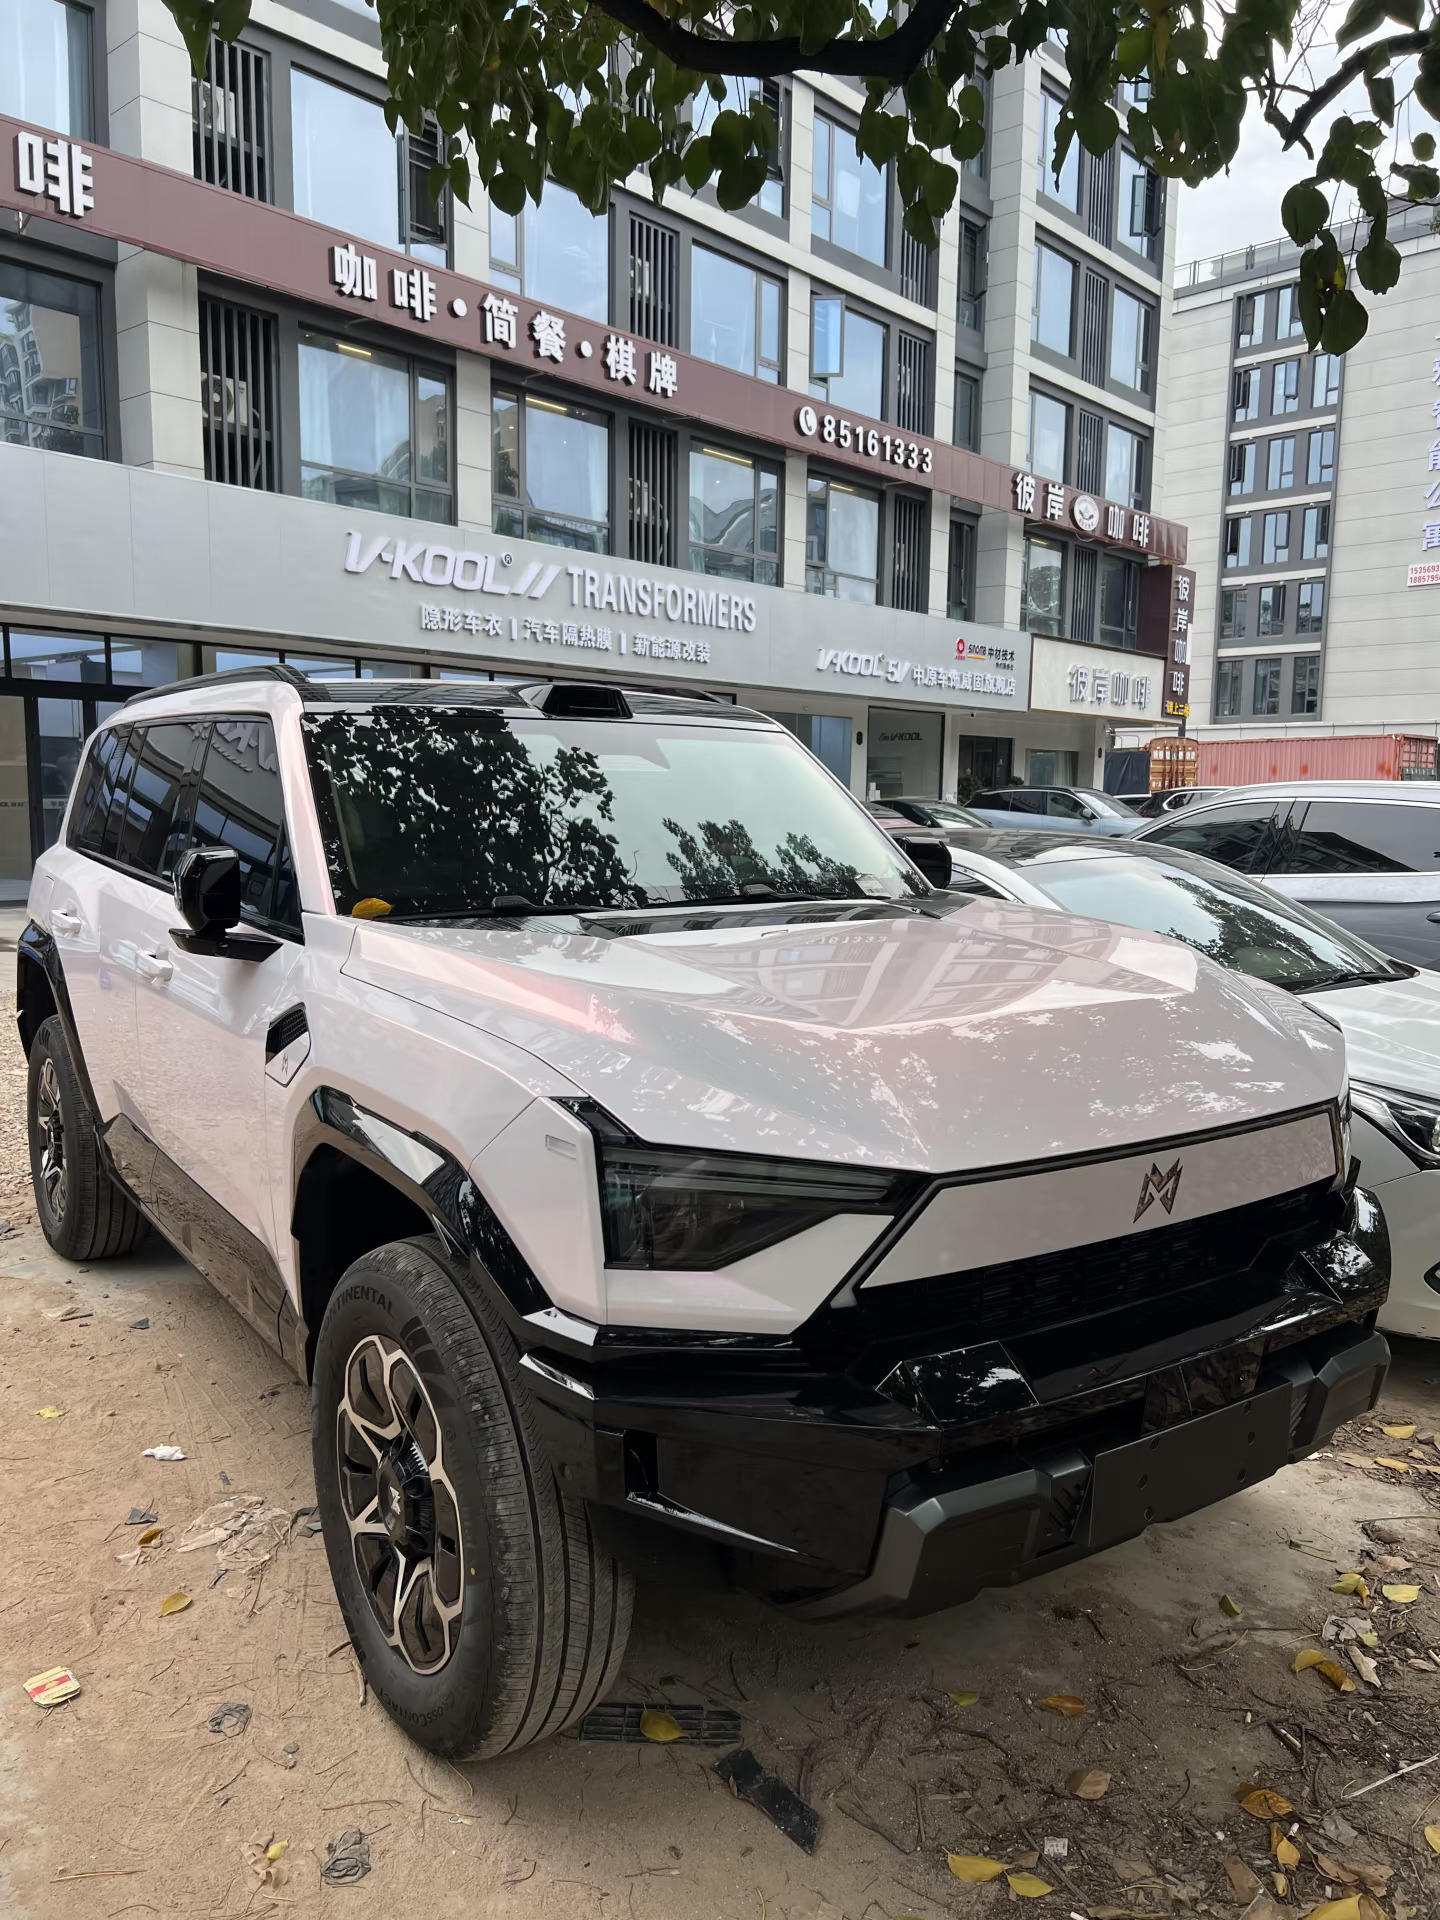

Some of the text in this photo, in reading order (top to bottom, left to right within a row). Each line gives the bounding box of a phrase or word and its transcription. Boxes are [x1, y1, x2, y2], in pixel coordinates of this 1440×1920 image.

[15, 131, 94, 217] 啡
[821, 414, 933, 474] 85161333
[1014, 472, 1150, 548] 彼岸 咖啡
[566, 566, 758, 633] TRANSFORMERS
[1409, 574, 1440, 584] 1885795
[420, 603, 712, 664] 隐形车衣 汽车隔热膜 新能源改装
[1173, 575, 1190, 697] 彼岸咖啡
[1070, 665, 1151, 710] 彼岸咖啡
